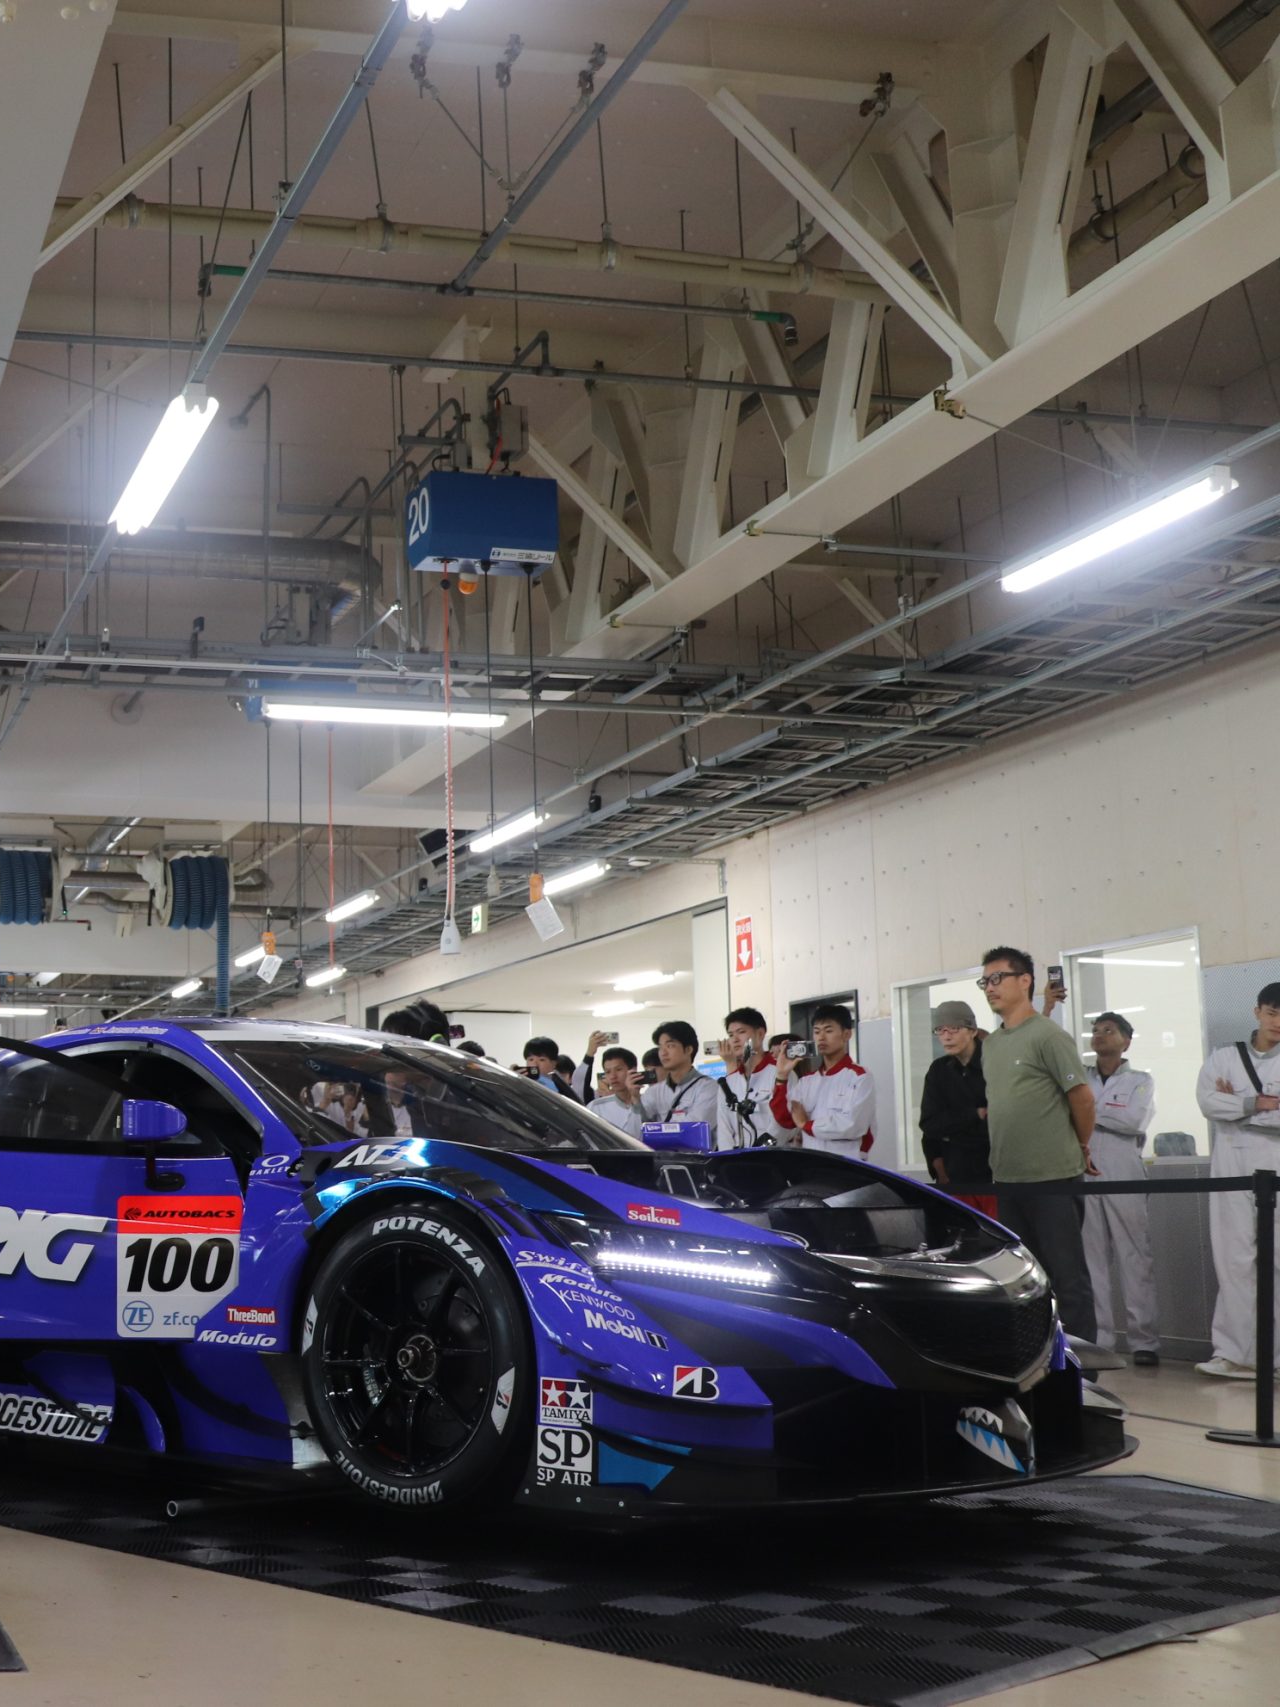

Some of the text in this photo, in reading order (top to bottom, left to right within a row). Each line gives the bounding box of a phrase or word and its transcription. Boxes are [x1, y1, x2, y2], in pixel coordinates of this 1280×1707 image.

[408, 487, 430, 546] 20
[249, 1166, 291, 1176] OAKLEY
[143, 1207, 235, 1218] AUTOBACS
[372, 1216, 486, 1277] POTENZA
[125, 1237, 234, 1293] 100
[540, 1273, 622, 1302] Modulo
[125, 1307, 151, 1326] ZF
[227, 1307, 276, 1323] ThreeBond
[559, 1290, 635, 1321] KENWOOD
[197, 1329, 277, 1347] Modulo
[584, 1308, 646, 1344] Mobil
[542, 1407, 591, 1421] TAMIYA
[539, 1428, 591, 1467] SP
[333, 1450, 442, 1505] BRIDGESTONE
[537, 1467, 592, 1486] SP AIR
